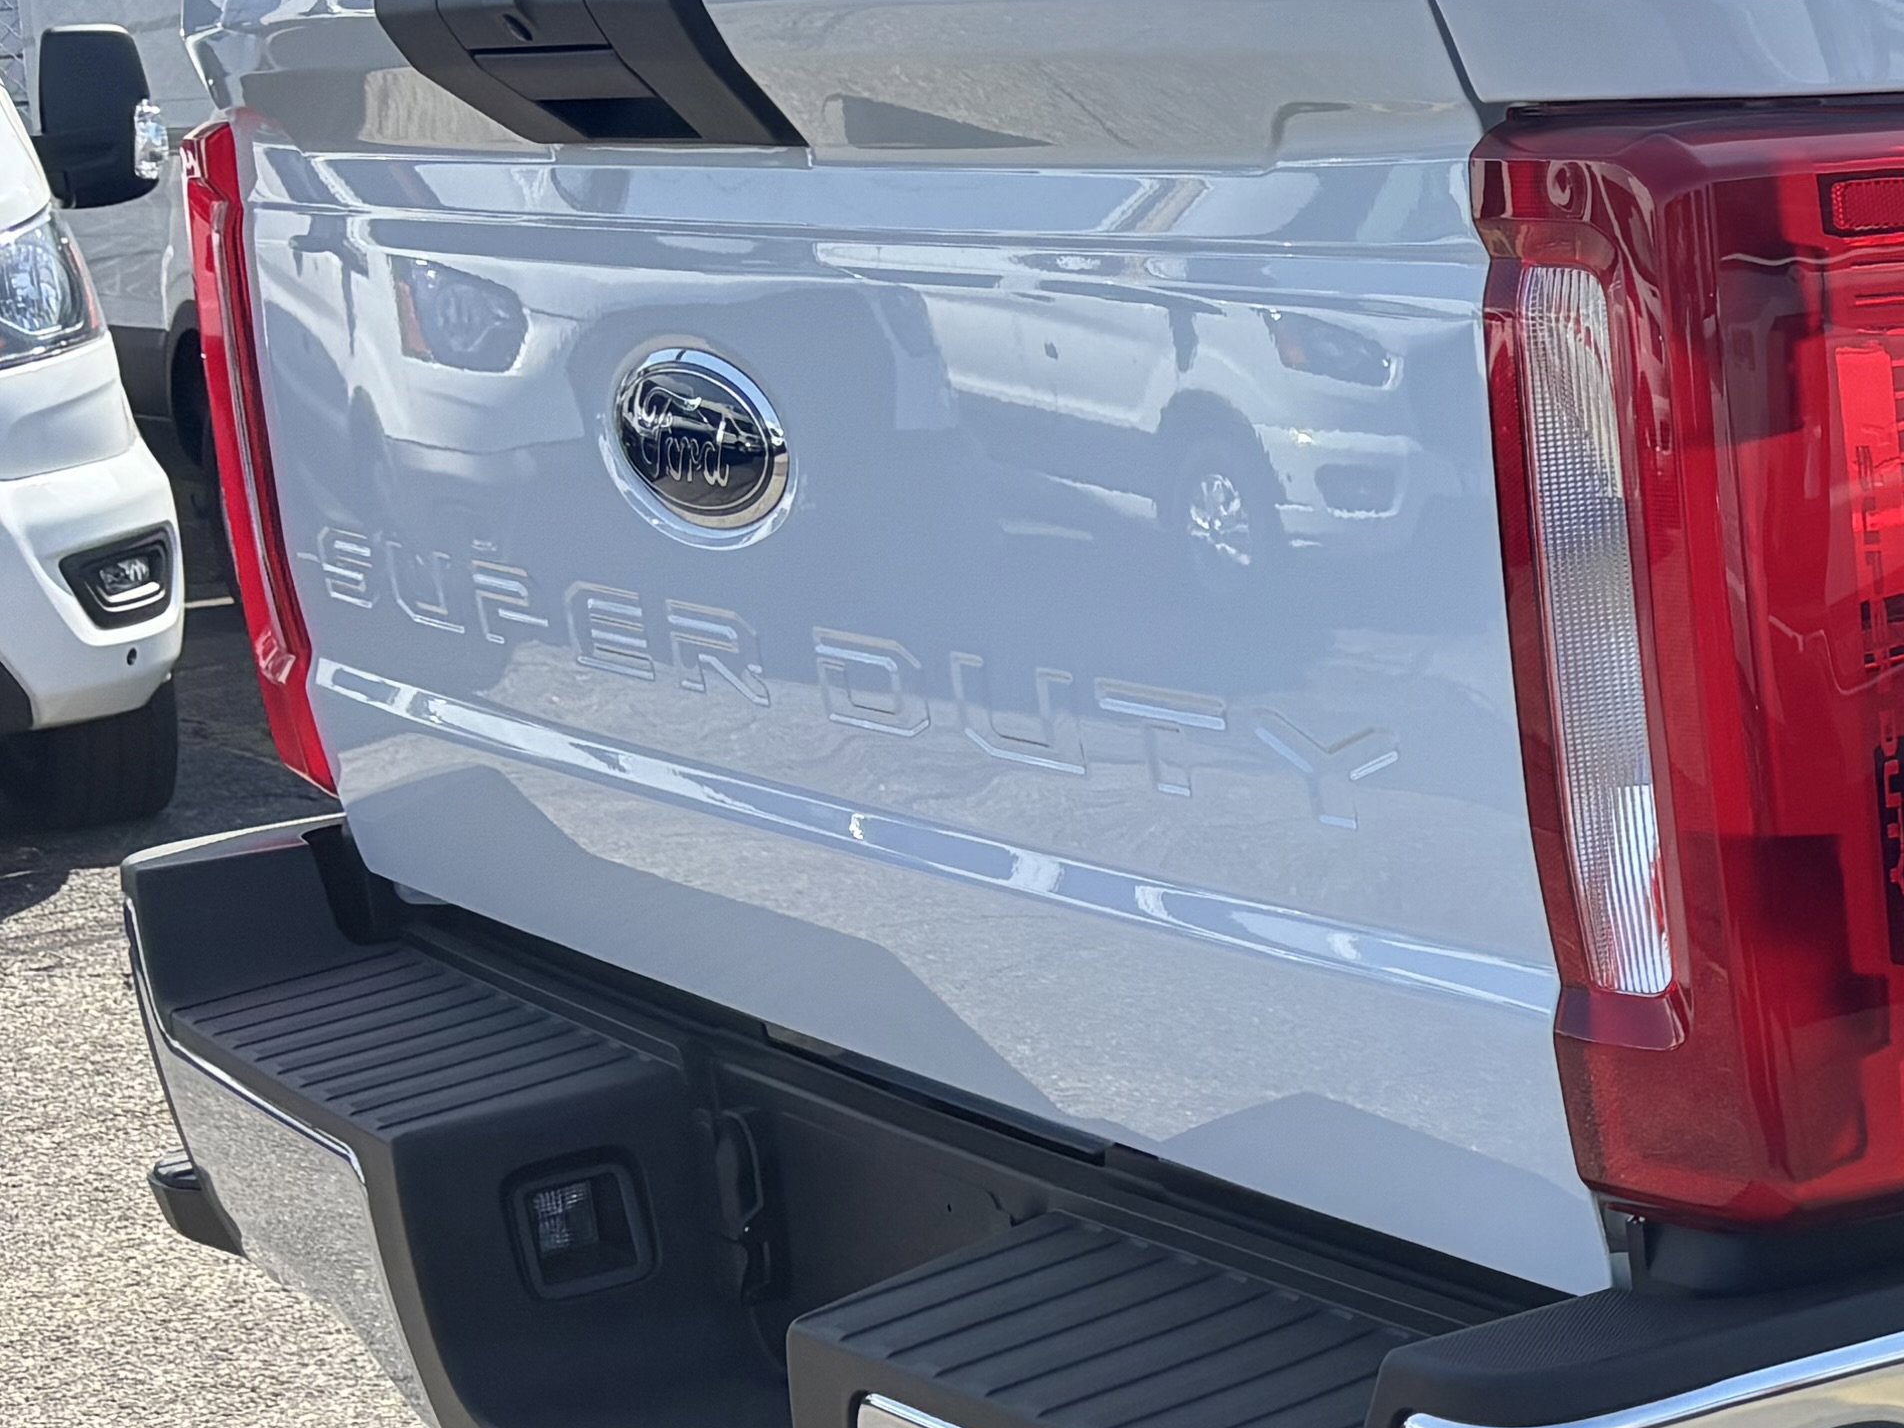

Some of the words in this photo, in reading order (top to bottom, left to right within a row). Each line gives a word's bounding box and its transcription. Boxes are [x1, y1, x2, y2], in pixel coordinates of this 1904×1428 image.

[634, 384, 730, 488] Ford
[314, 525, 770, 708] SUPER
[811, 622, 1402, 832] DUTY
